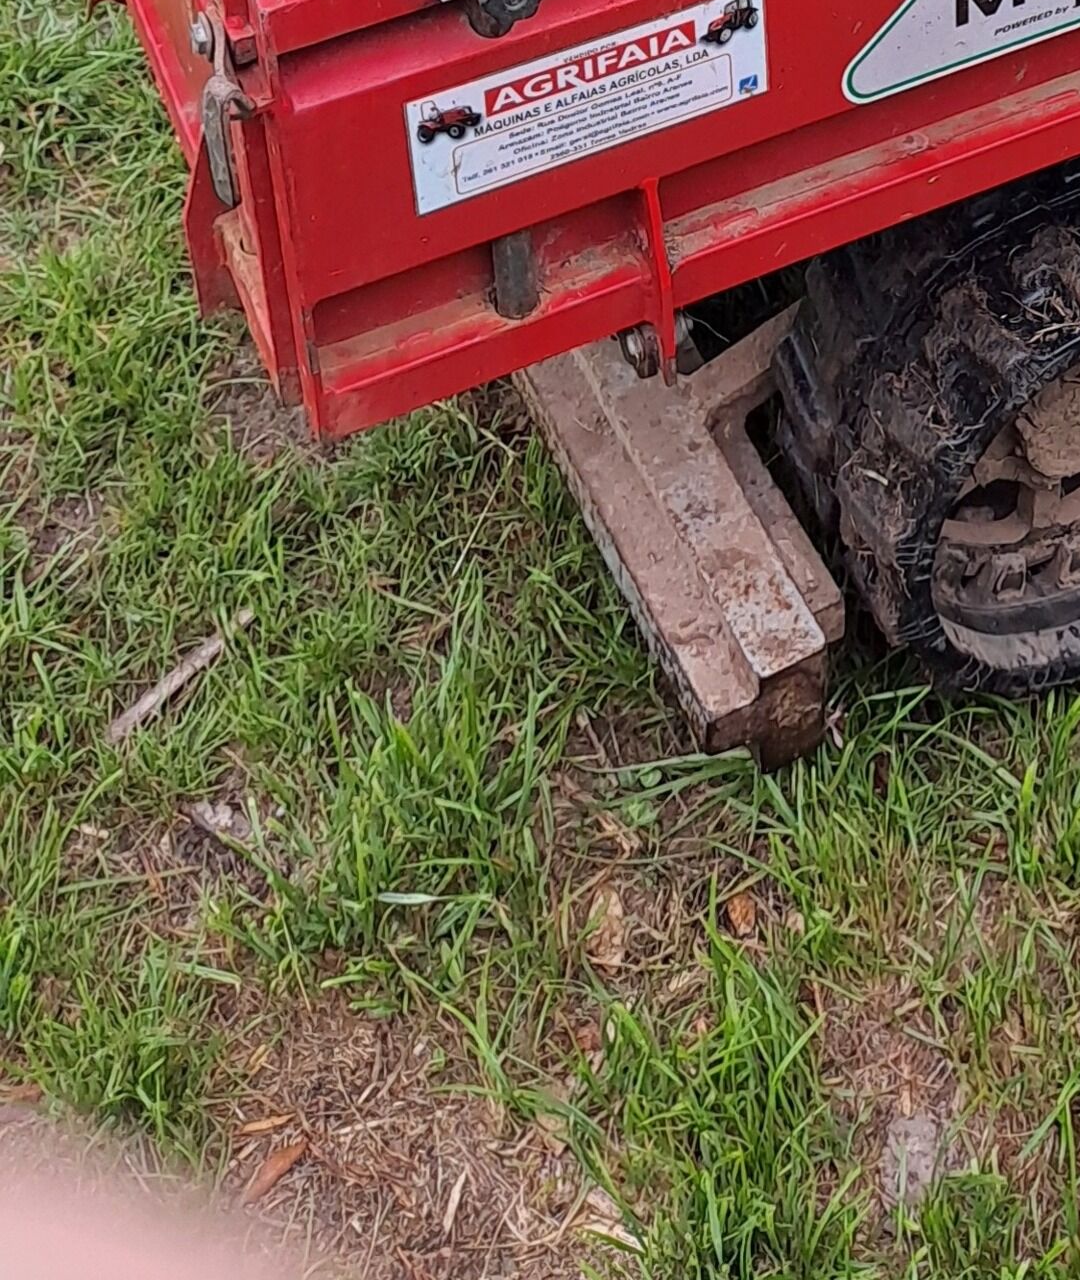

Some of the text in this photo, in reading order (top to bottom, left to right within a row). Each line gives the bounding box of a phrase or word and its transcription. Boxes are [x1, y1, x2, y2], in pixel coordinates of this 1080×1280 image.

[994, 9, 1054, 36] POWERED
[1054, 4, 1069, 18] by
[490, 28, 691, 111] AGRIFAIA
[544, 102, 552, 113] E
[555, 85, 605, 108] ALFAIAS
[686, 49, 708, 63] LDA
